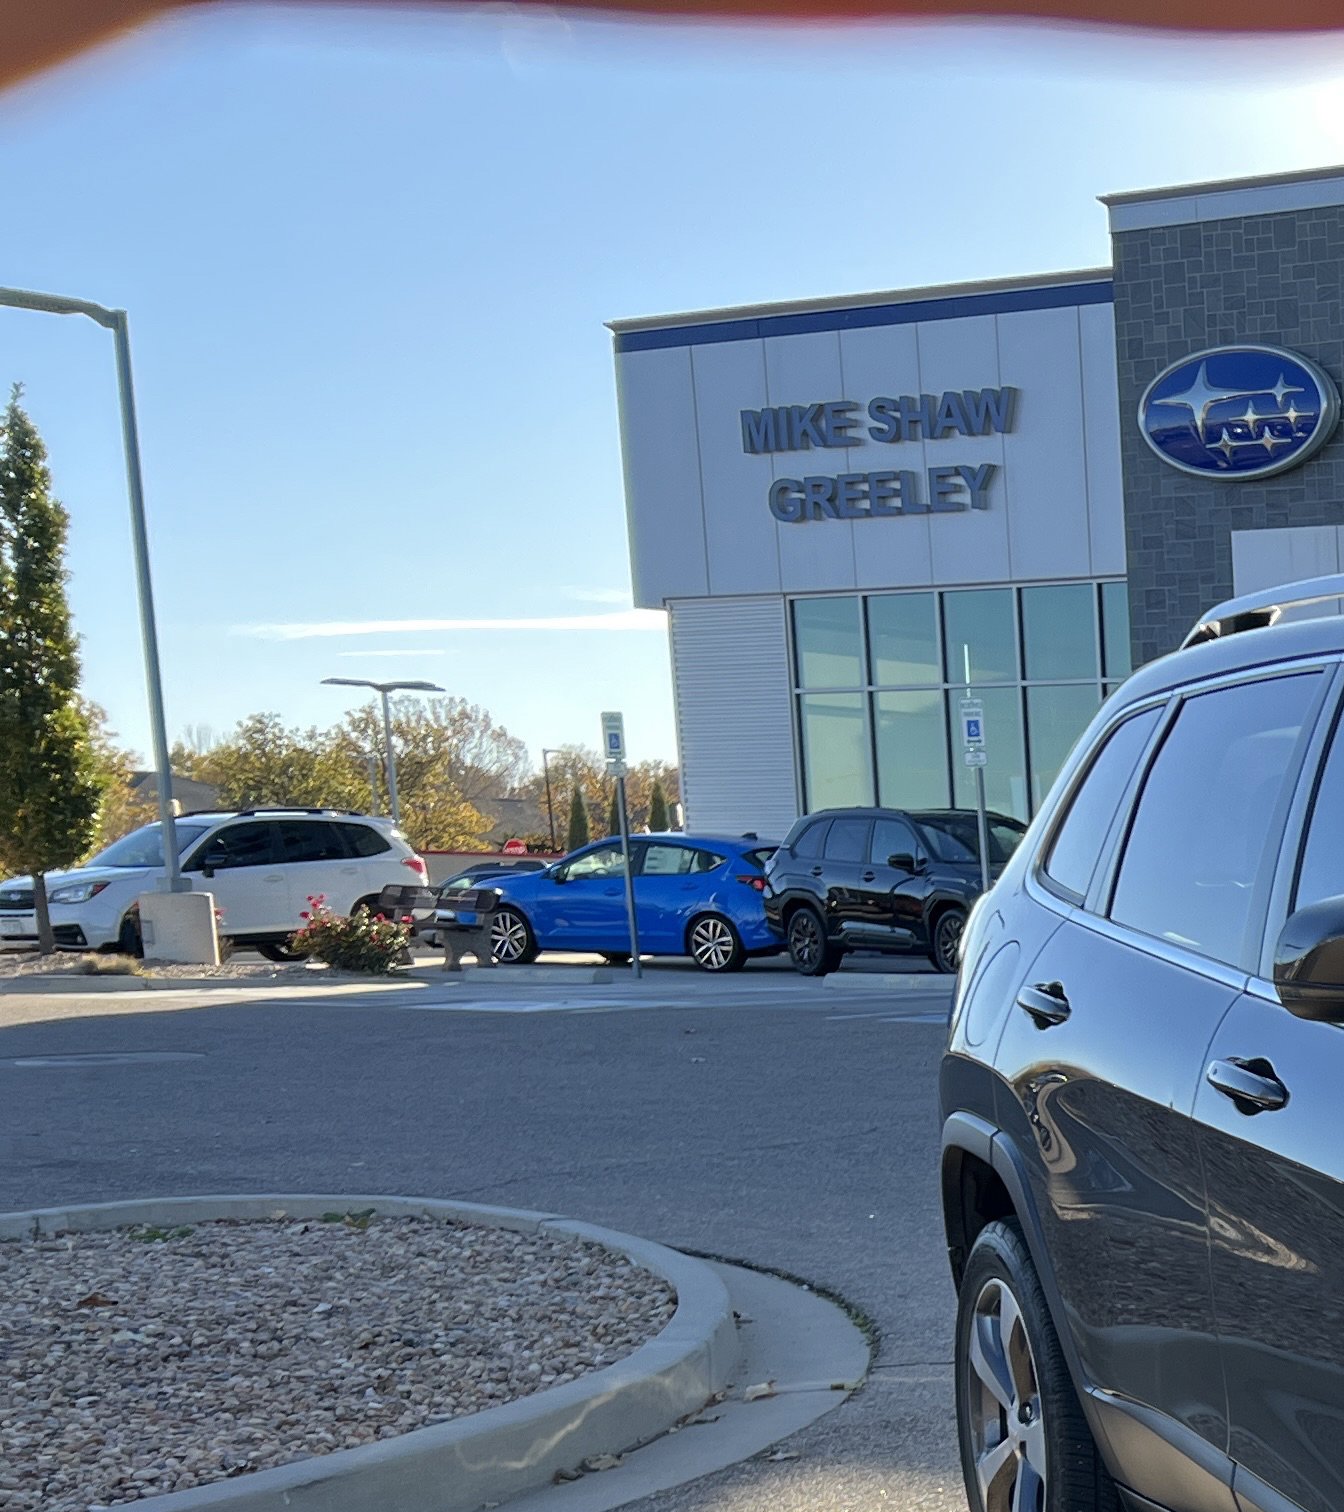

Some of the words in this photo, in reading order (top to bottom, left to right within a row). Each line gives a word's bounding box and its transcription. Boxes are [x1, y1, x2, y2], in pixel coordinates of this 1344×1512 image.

[741, 400, 864, 454] MIKE
[868, 386, 1018, 443] SHAW
[769, 464, 998, 523] GREELEY
